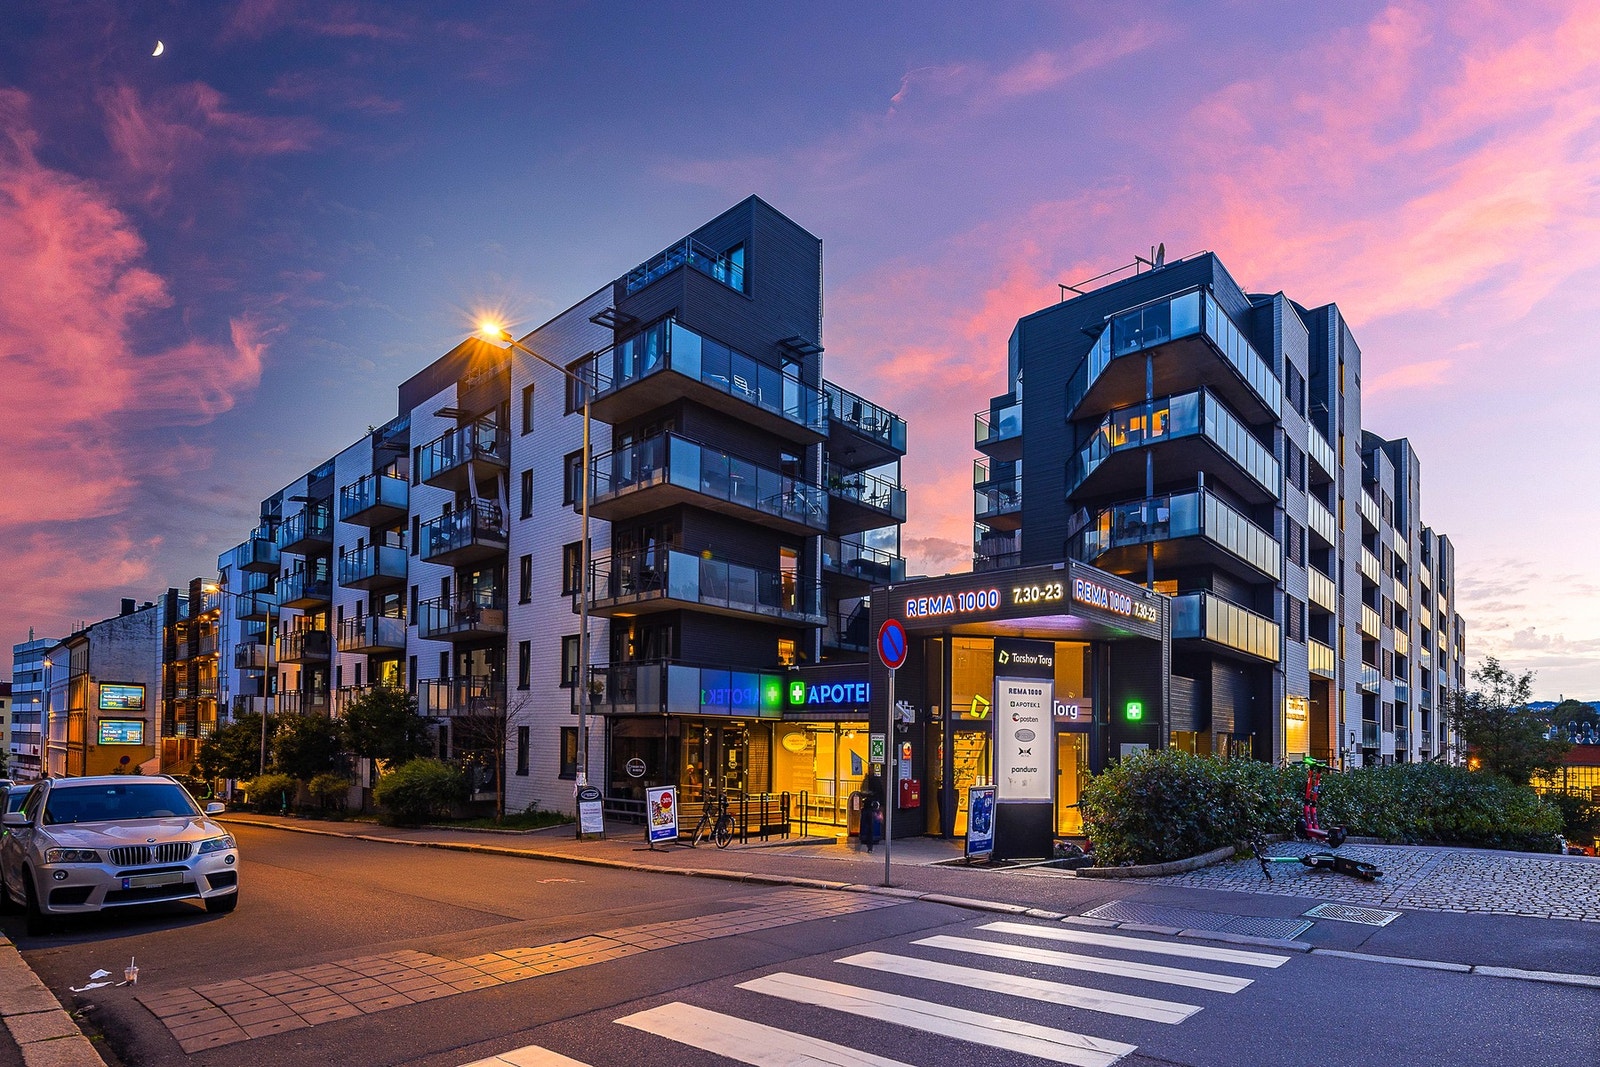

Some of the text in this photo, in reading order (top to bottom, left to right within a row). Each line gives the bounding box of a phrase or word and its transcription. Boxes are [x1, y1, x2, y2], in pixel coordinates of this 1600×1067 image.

[906, 583, 1063, 617] REMA 1000 7.30-23
[1076, 579, 1156, 622] REMA 1000 7.30-23
[1011, 652, 1053, 667] Torshov Torg
[808, 683, 870, 704] APOTE
[1008, 687, 1043, 696] REMA 1000
[1011, 765, 1038, 774] panduro
